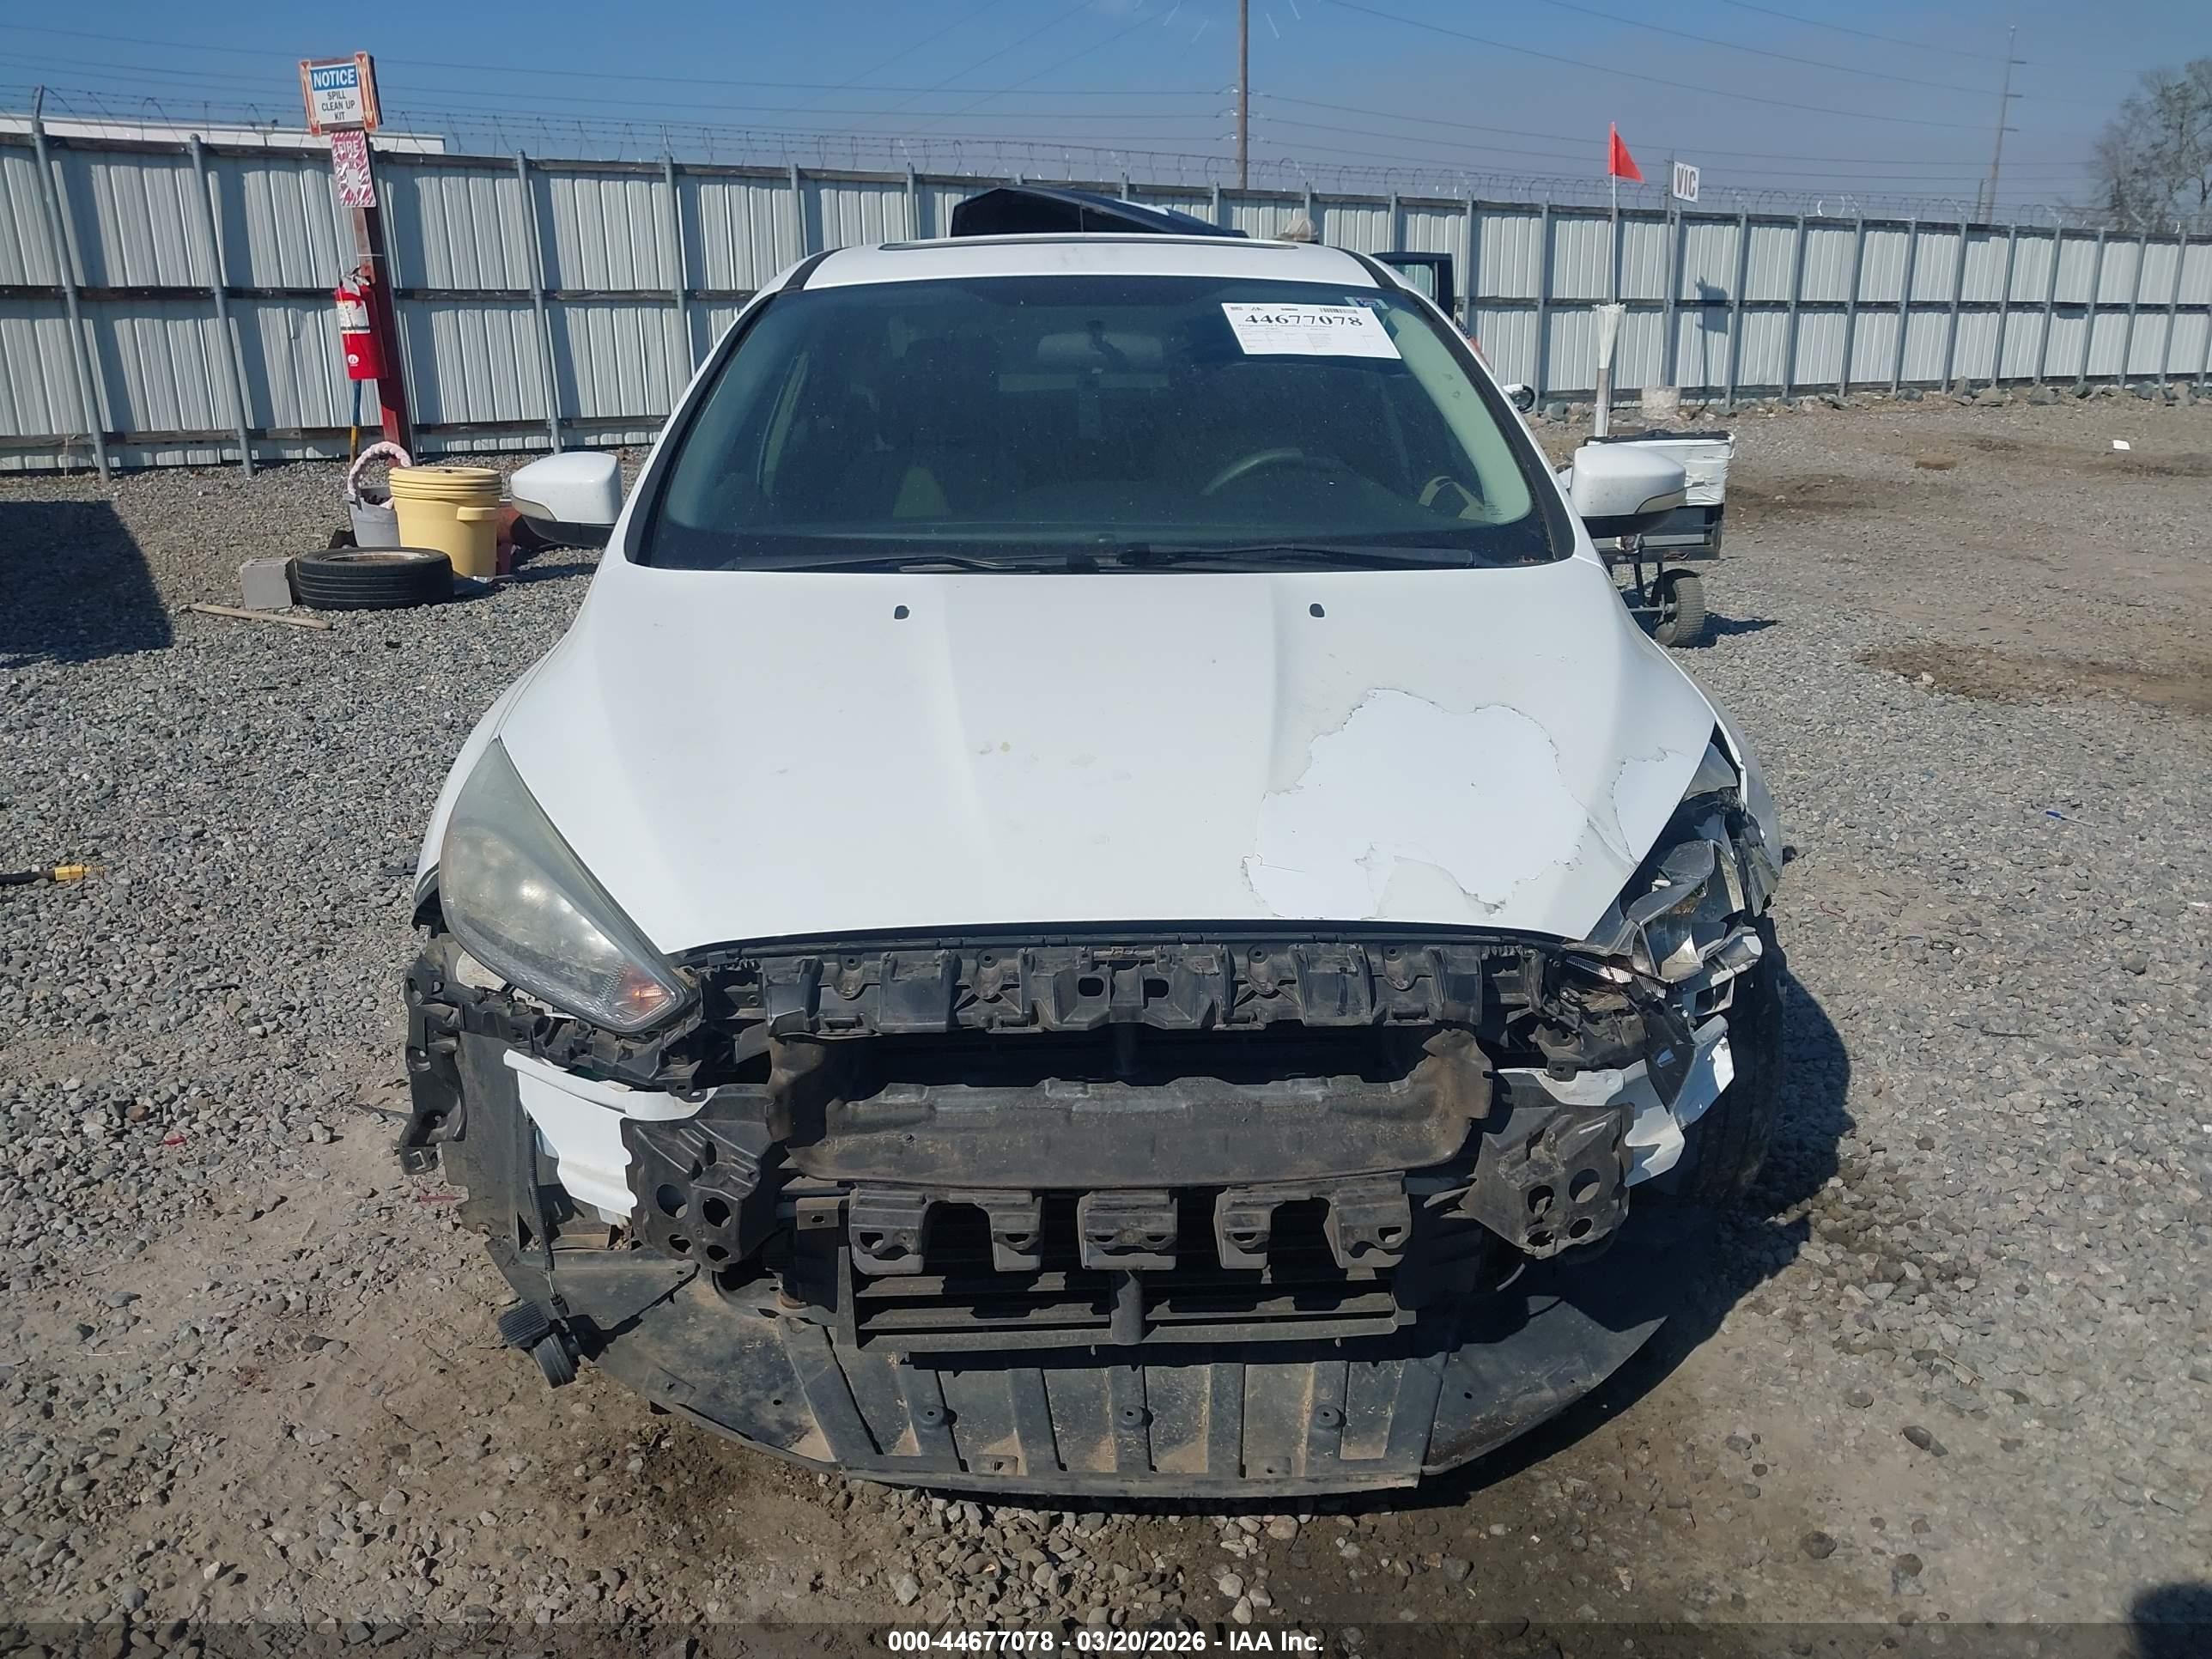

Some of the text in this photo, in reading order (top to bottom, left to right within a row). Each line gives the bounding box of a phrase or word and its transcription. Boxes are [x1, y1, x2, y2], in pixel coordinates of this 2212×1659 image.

[313, 69, 356, 88] NOTICE
[327, 90, 347, 100] SPILL
[321, 100, 356, 112] CLEAN UP
[334, 111, 345, 121] KIT
[336, 140, 359, 153] FIRE
[1677, 167, 1696, 198] VIC
[1244, 314, 1363, 327] 44677078
